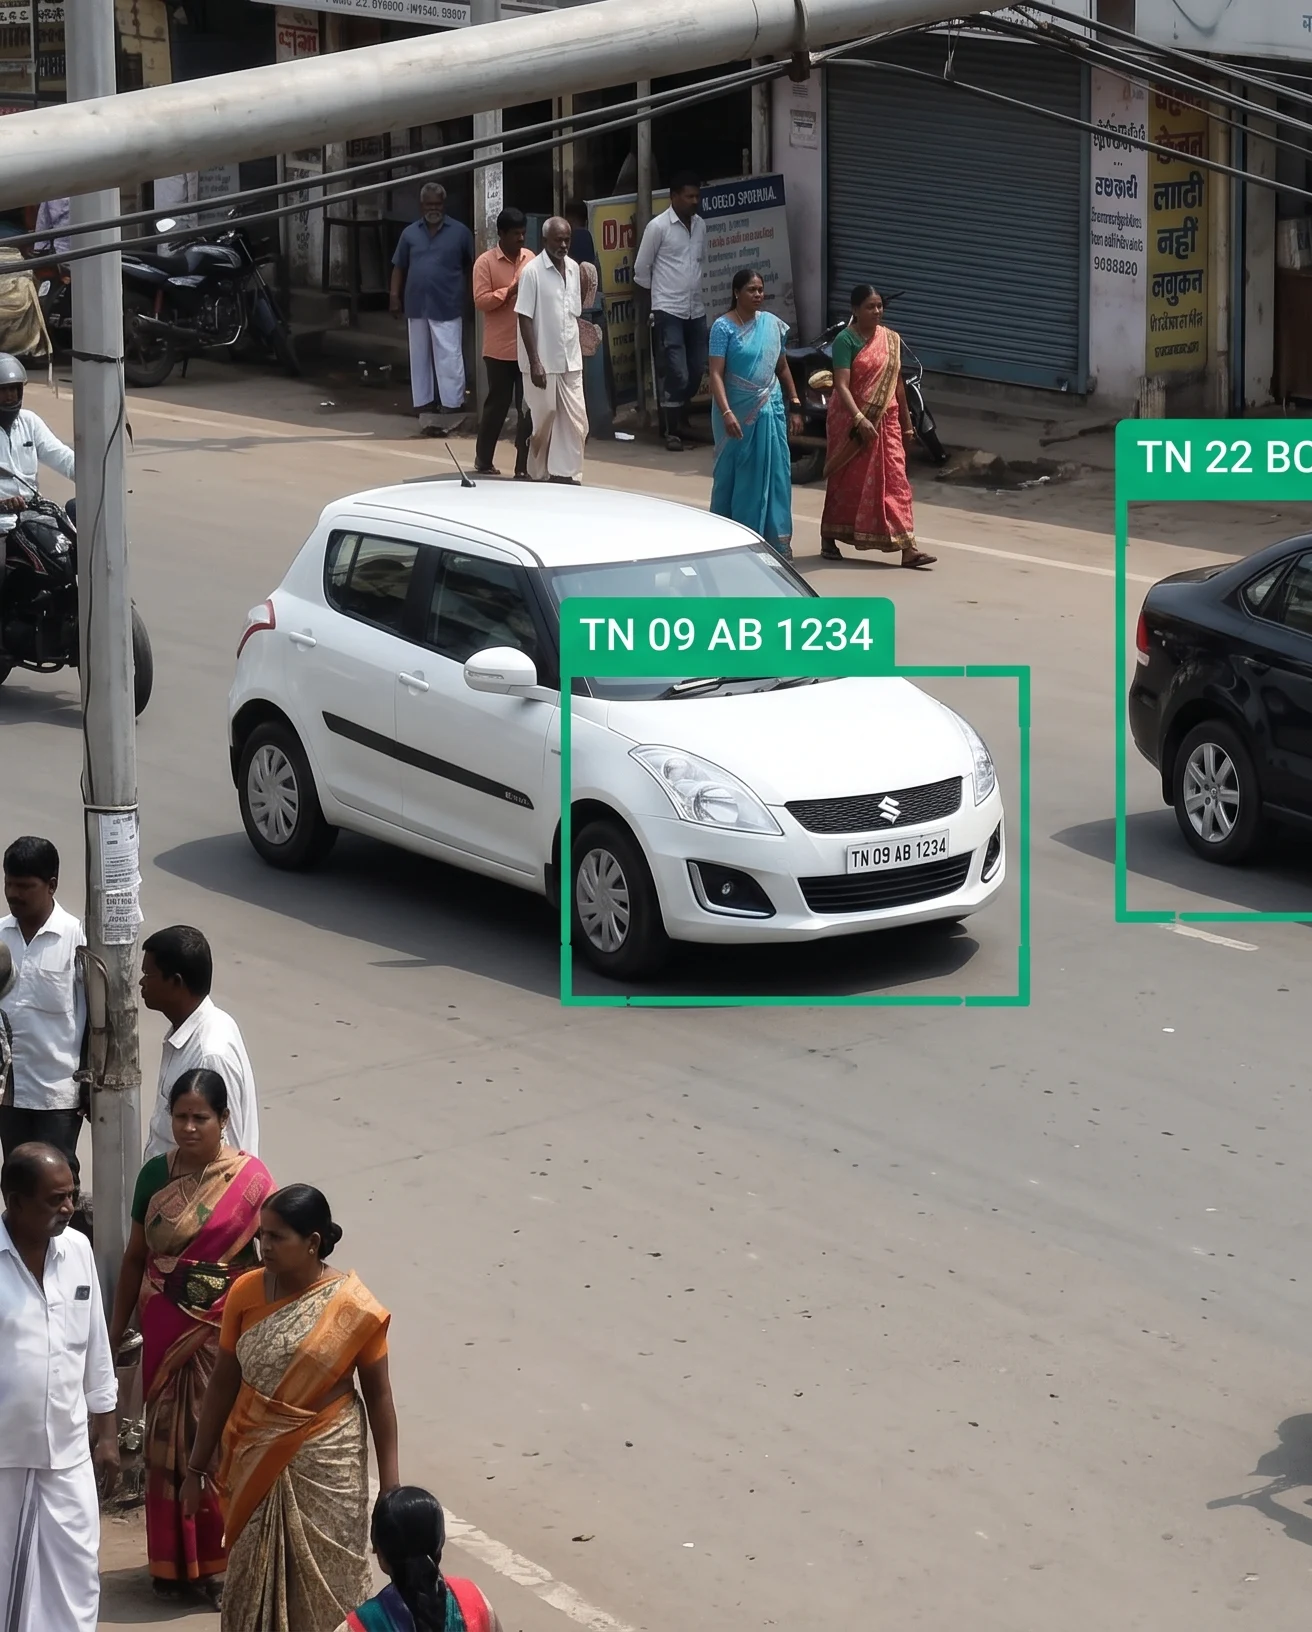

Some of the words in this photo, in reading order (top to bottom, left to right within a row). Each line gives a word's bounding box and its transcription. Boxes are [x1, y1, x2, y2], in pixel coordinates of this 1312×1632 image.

[1157, 216, 1198, 260] नहीं
[852, 849, 869, 868] TN
[873, 847, 891, 865] 09
[894, 844, 911, 862] AB
[916, 837, 946, 858] 1234
